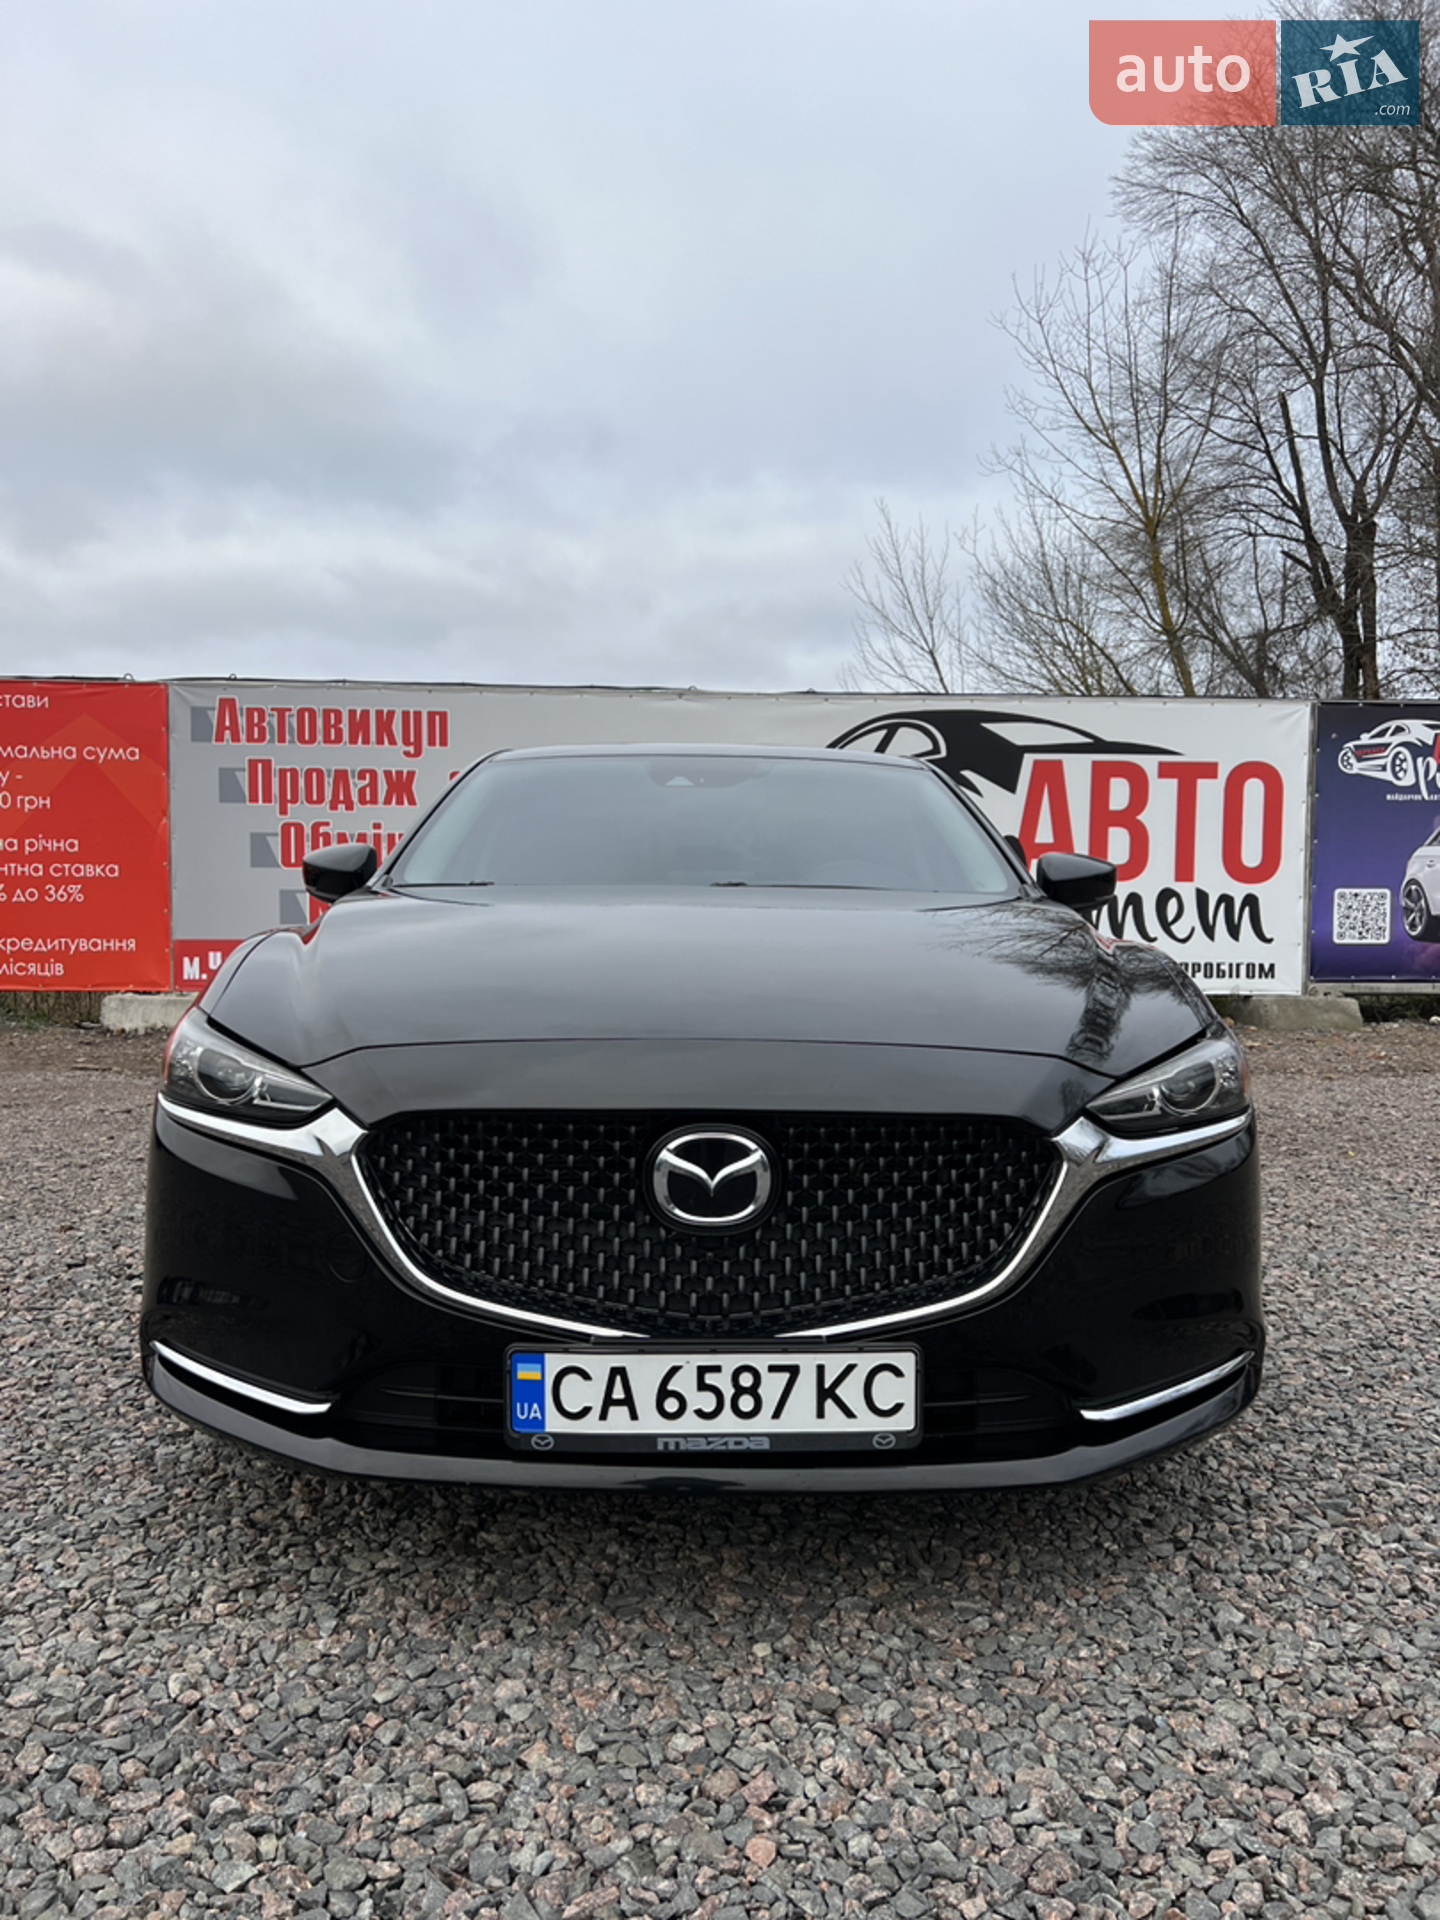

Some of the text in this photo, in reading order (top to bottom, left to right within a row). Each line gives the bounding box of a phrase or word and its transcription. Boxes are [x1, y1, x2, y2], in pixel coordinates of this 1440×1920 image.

[213, 697, 450, 758] Автовикуп
[82, 746, 140, 764] сума
[246, 757, 418, 815] Продаж
[16, 795, 51, 814] грн
[1016, 758, 1285, 885] АВТО
[24, 833, 80, 856] річна
[280, 820, 405, 869] Обі
[49, 862, 120, 878] ставка
[11, 888, 39, 903] до
[44, 884, 85, 903] 36%
[551, 1362, 907, 1422] CA 6587 KC
[516, 1402, 543, 1420] UA
